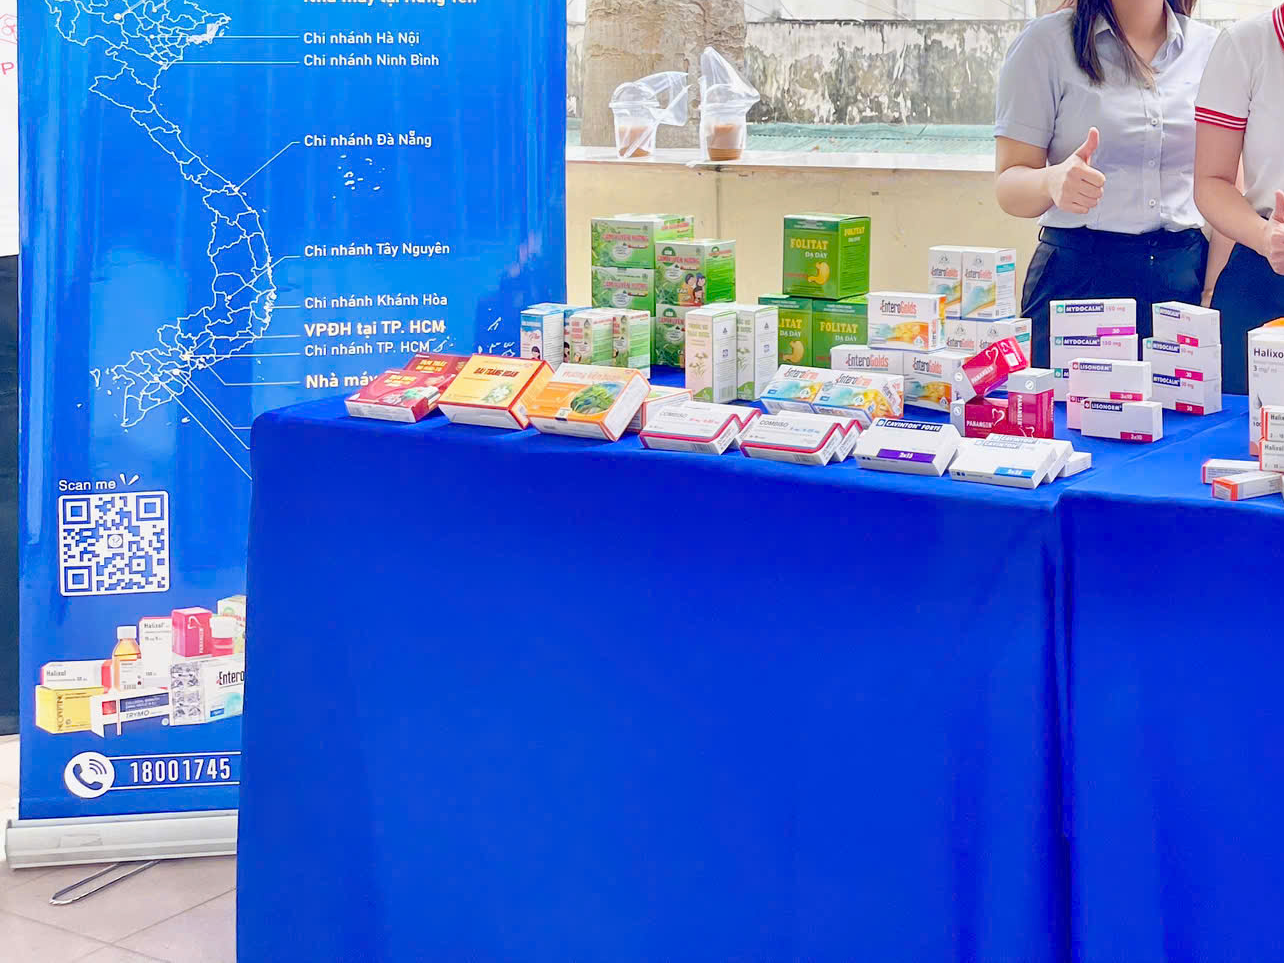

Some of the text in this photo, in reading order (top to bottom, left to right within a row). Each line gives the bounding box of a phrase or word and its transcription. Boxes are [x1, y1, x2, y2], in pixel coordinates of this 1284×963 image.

[303, 31, 420, 47] Chi nhánh Hà Nội
[304, 53, 439, 66] Chi nhánh Ninh Bình
[304, 130, 432, 148] Chi nhánh Đà Nẵng
[304, 242, 450, 257] Chi nhánh Tây Nguyên
[790, 238, 829, 250] FOLITAT
[304, 292, 448, 309] Chi nhánh Khánh Hòa
[880, 299, 917, 315] EnteroGolds
[304, 319, 445, 338] VPĐH tại TP. HCM
[780, 318, 803, 329] ITAT
[820, 321, 858, 334] FOLITAT
[304, 340, 430, 356] Chi nhánh TP. HCM
[845, 353, 889, 368] EnteroGolds
[306, 373, 339, 389] Nhà
[885, 420, 942, 431] CAVINTON FORTE
[58, 480, 116, 491] Scan me
[125, 709, 150, 719] TRYMO
[130, 757, 231, 783] 18001745
